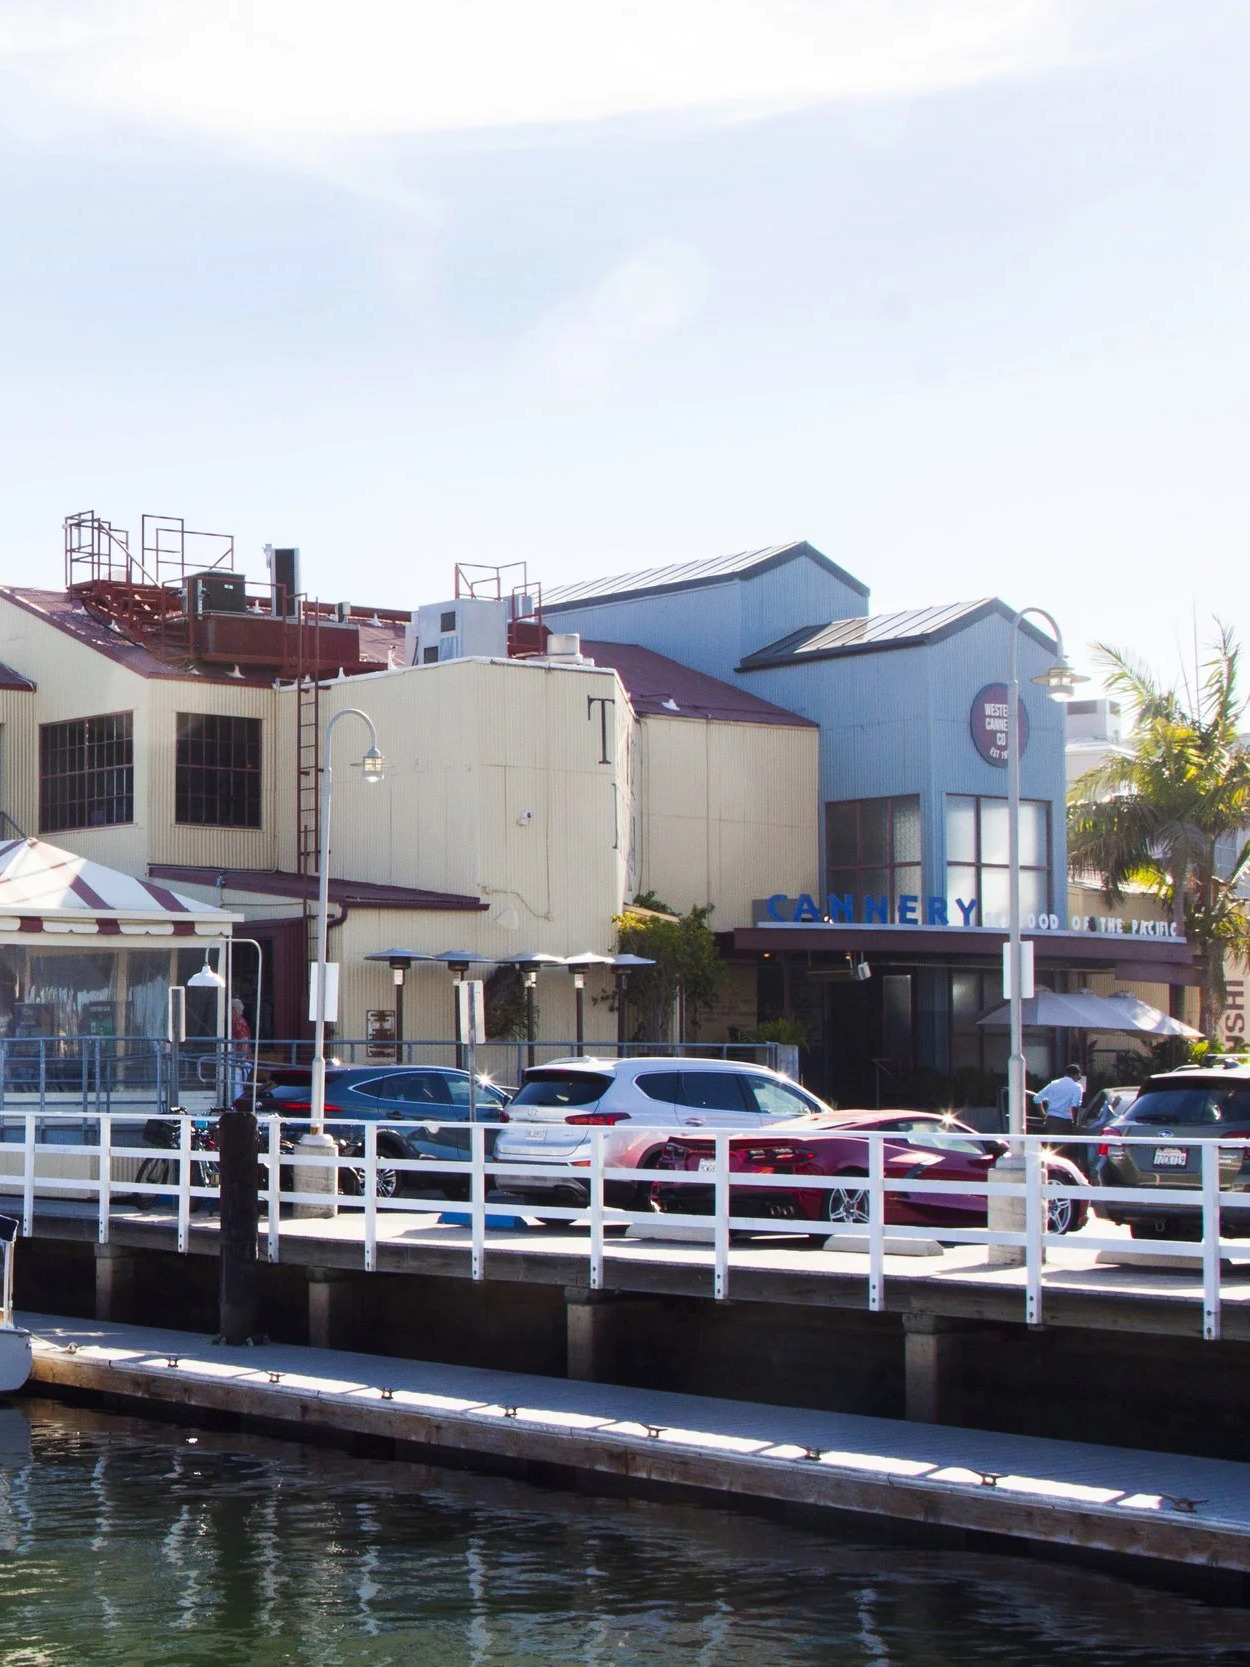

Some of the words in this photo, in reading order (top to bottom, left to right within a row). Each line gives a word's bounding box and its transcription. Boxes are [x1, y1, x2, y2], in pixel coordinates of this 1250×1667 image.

[996, 732, 1006, 746] CO
[989, 747, 1000, 759] EST
[765, 893, 978, 926] CANNERY
[1099, 916, 1123, 934] THE
[1131, 919, 1178, 937] PACIFIC
